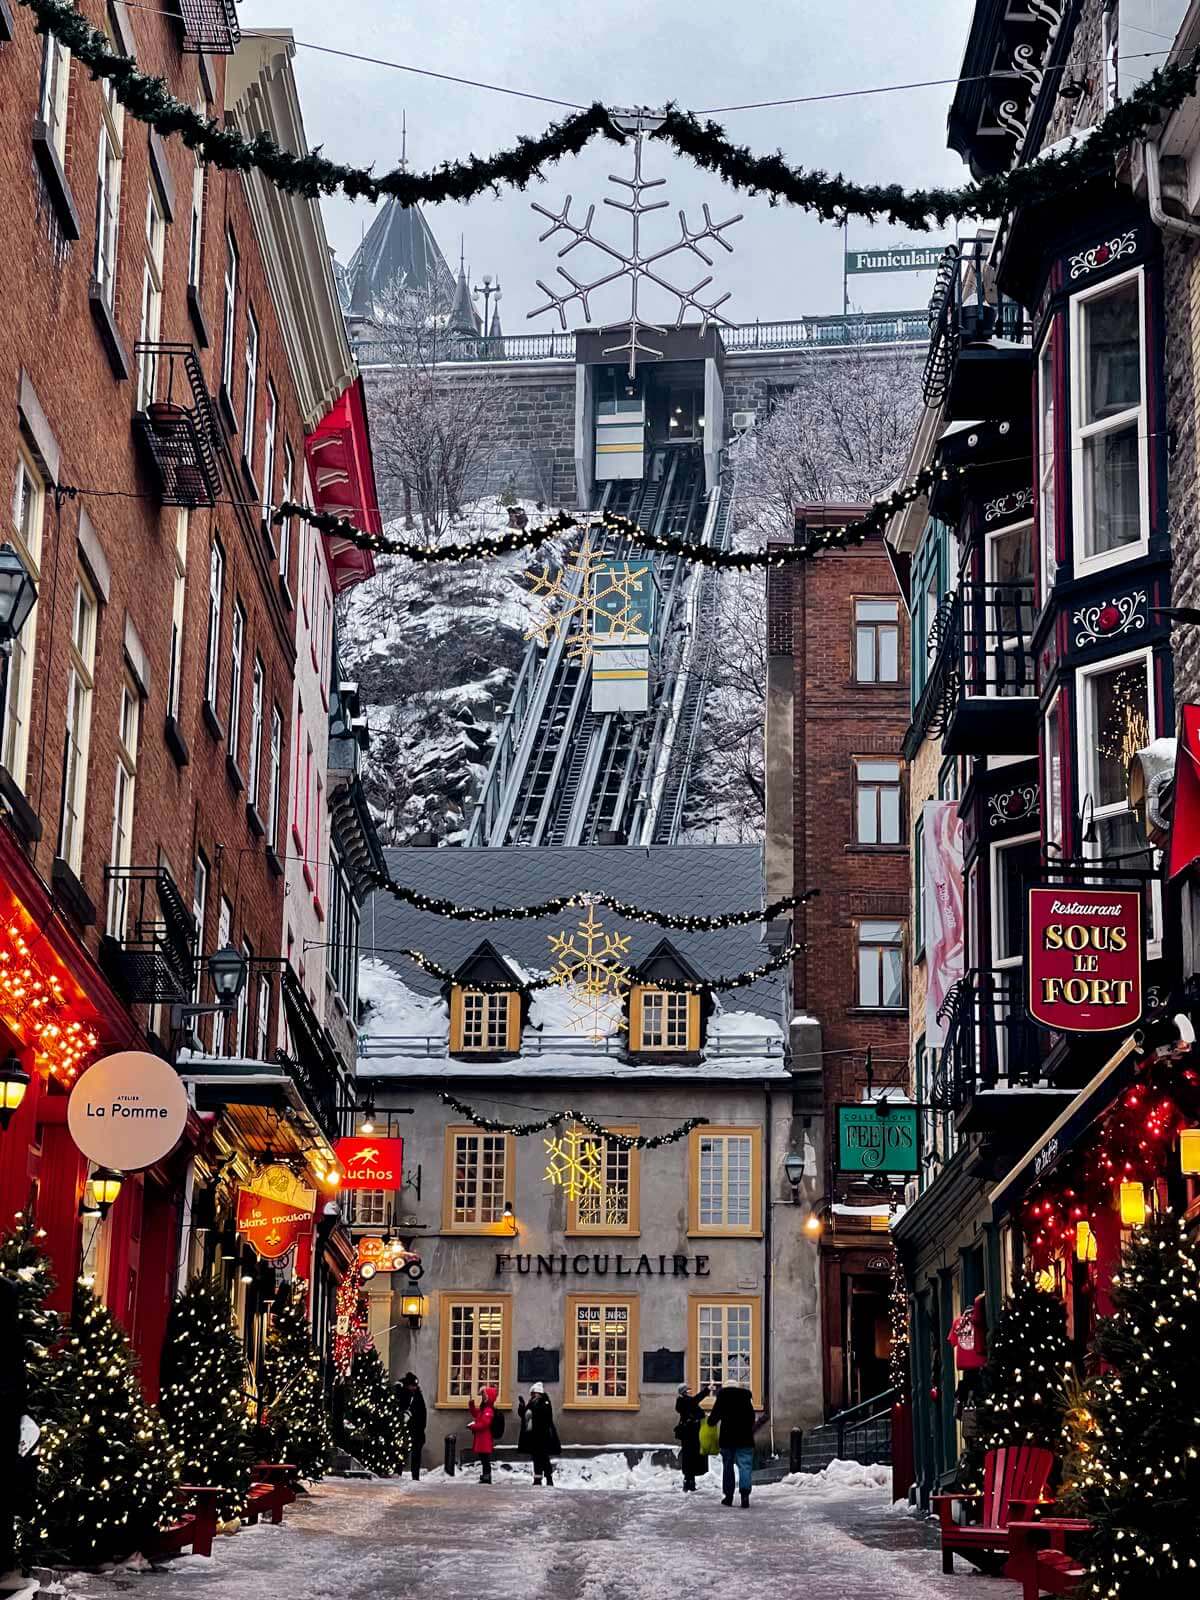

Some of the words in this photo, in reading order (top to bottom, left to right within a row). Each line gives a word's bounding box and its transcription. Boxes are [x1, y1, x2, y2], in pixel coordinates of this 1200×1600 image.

[1050, 900, 1122, 916] Restaurant
[1044, 924, 1128, 952] SOUS
[1073, 954, 1099, 973] LE
[1041, 977, 1133, 1005] FORT
[86, 1103, 106, 1118] La
[111, 1103, 169, 1119] Pomme
[239, 1217, 268, 1229] blanc
[271, 1211, 312, 1225] mouton
[495, 1253, 711, 1276] FUNICULAIRE
